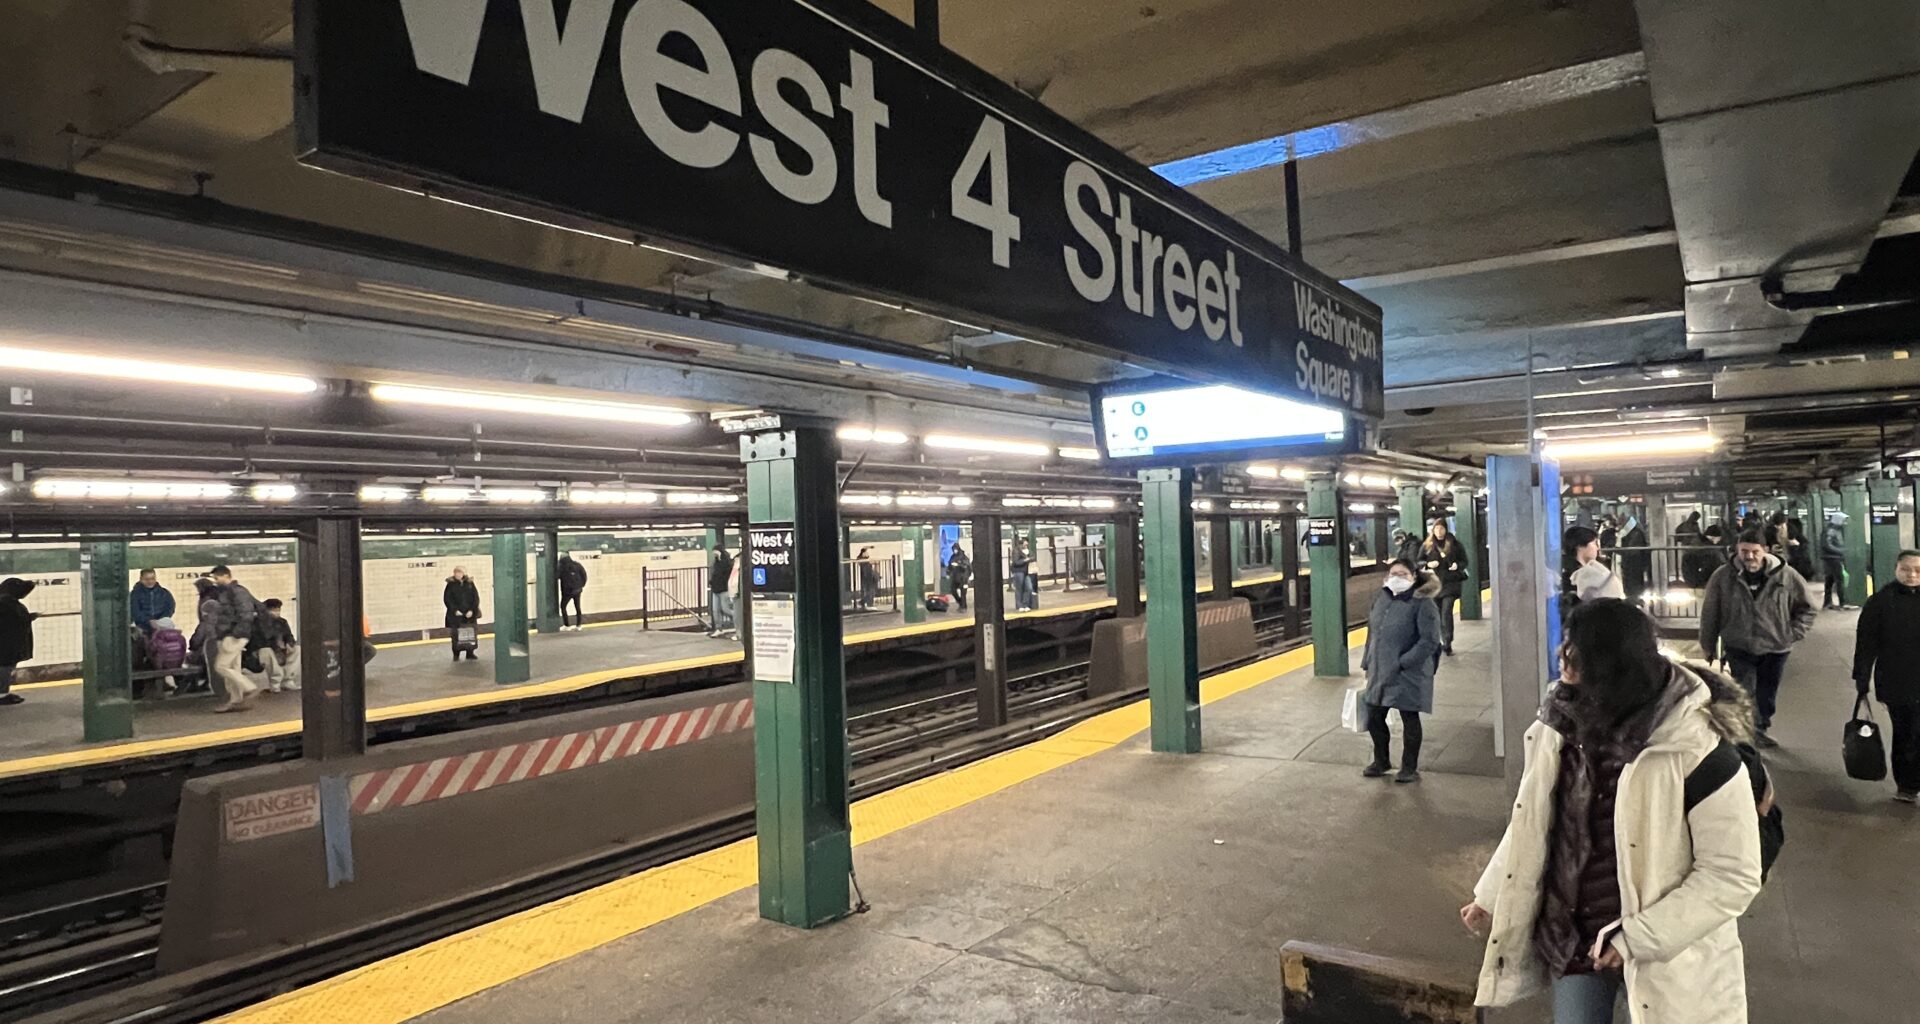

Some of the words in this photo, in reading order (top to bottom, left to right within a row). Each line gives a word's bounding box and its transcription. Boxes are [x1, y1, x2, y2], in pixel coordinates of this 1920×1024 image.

[951, 114, 1021, 268] 4
[1063, 160, 1243, 347] Street
[1293, 280, 1376, 362] Washington
[1295, 340, 1351, 402] Square
[750, 532, 782, 548] West
[784, 531, 793, 547] 4
[751, 549, 789, 565] Street
[229, 786, 317, 820] DANGER
